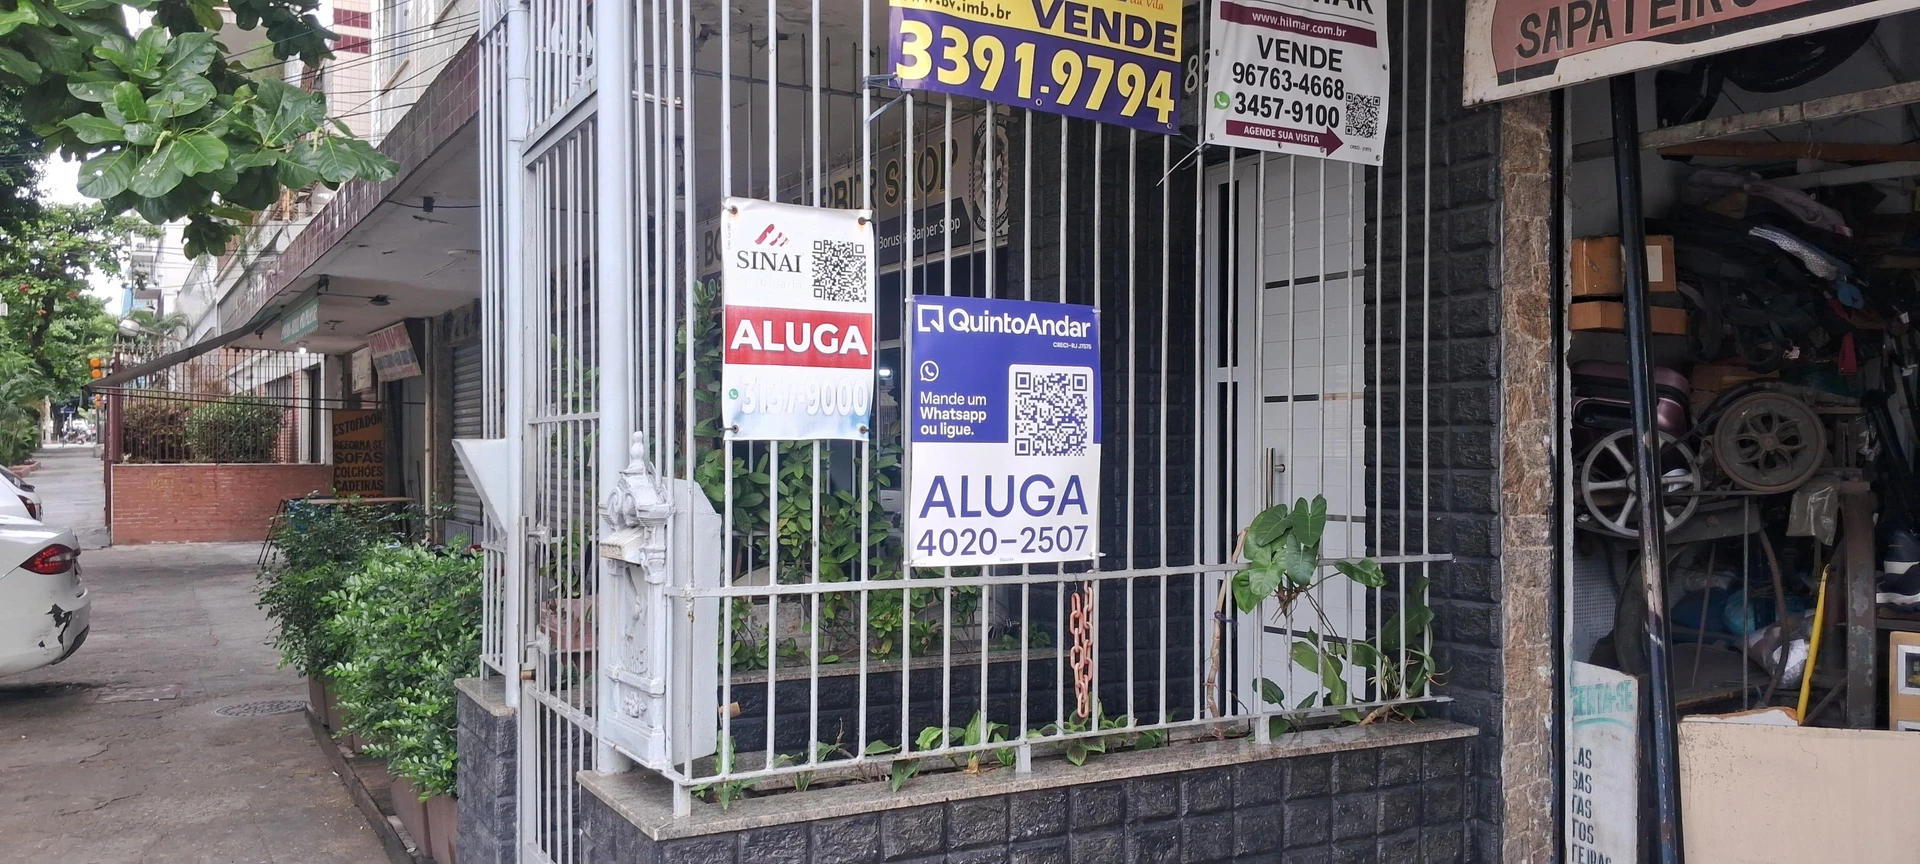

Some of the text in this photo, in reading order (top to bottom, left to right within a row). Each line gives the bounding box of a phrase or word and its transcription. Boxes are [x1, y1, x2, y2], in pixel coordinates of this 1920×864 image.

[901, 0, 1012, 20] .v.imb.br
[1251, 11, 1348, 37] www.hilmar.com.br
[1031, 0, 1179, 56] VENDE
[1514, 0, 1760, 59] SAPATE
[1256, 35, 1344, 72] VENDE
[1232, 62, 1345, 101] 96763-4668
[1234, 91, 1340, 129] 3457-9100
[1243, 125, 1320, 145] AGENDE SUA VISITA
[939, 217, 961, 234] Sop
[736, 250, 803, 274] SINAI
[729, 318, 869, 356] ALUGA
[948, 308, 1091, 338] QuintoAndar
[920, 391, 987, 406] Mande um
[920, 407, 987, 423] Whatsapp
[920, 423, 975, 438] ou ligue.
[335, 480, 384, 492] CADEIRAS
[919, 474, 1088, 518] ALUGA
[917, 525, 1089, 557] 4020-2507
